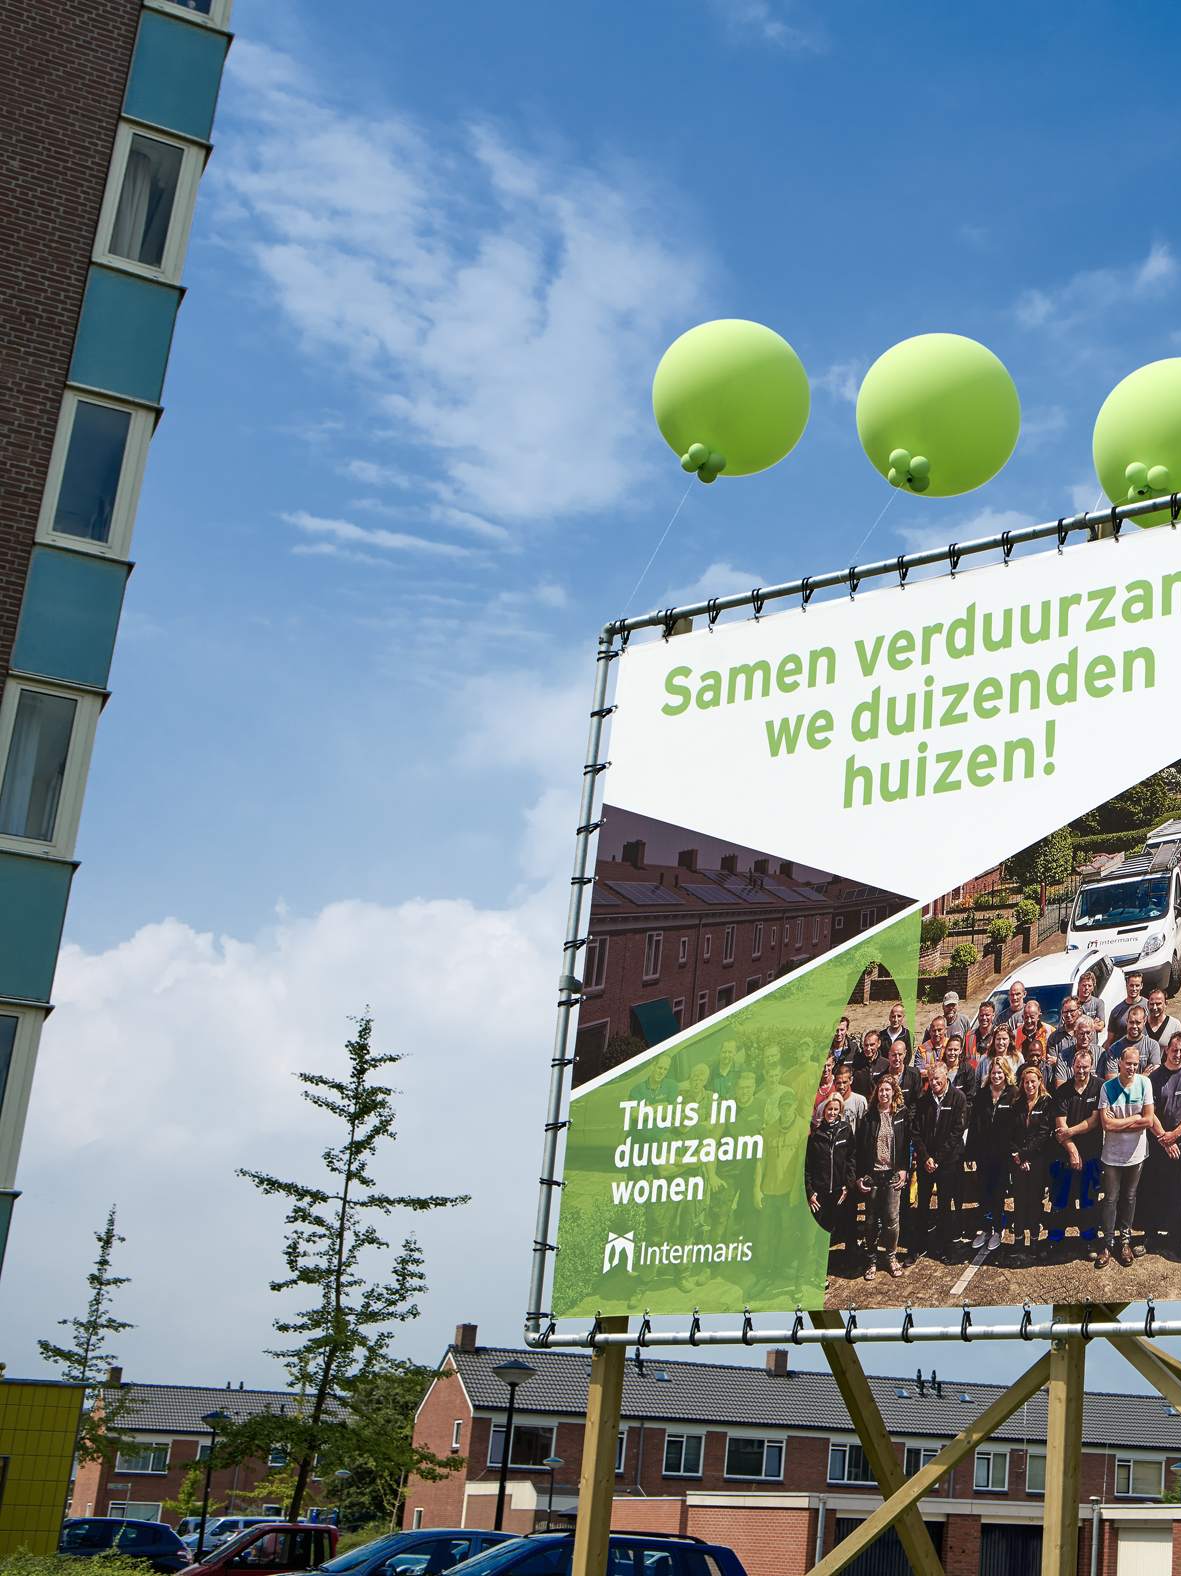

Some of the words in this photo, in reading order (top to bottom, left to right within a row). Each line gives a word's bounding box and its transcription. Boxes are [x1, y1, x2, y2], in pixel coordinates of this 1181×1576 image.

[661, 647, 838, 717] Samen
[765, 709, 835, 758] we
[851, 646, 1156, 743] duizenden
[842, 719, 1057, 810] huizen!
[619, 1095, 700, 1131] Thuis
[710, 1092, 737, 1125] in
[614, 1134, 764, 1169] duurzaam
[611, 1176, 705, 1205] wonen
[639, 1236, 753, 1266] Intermaris
